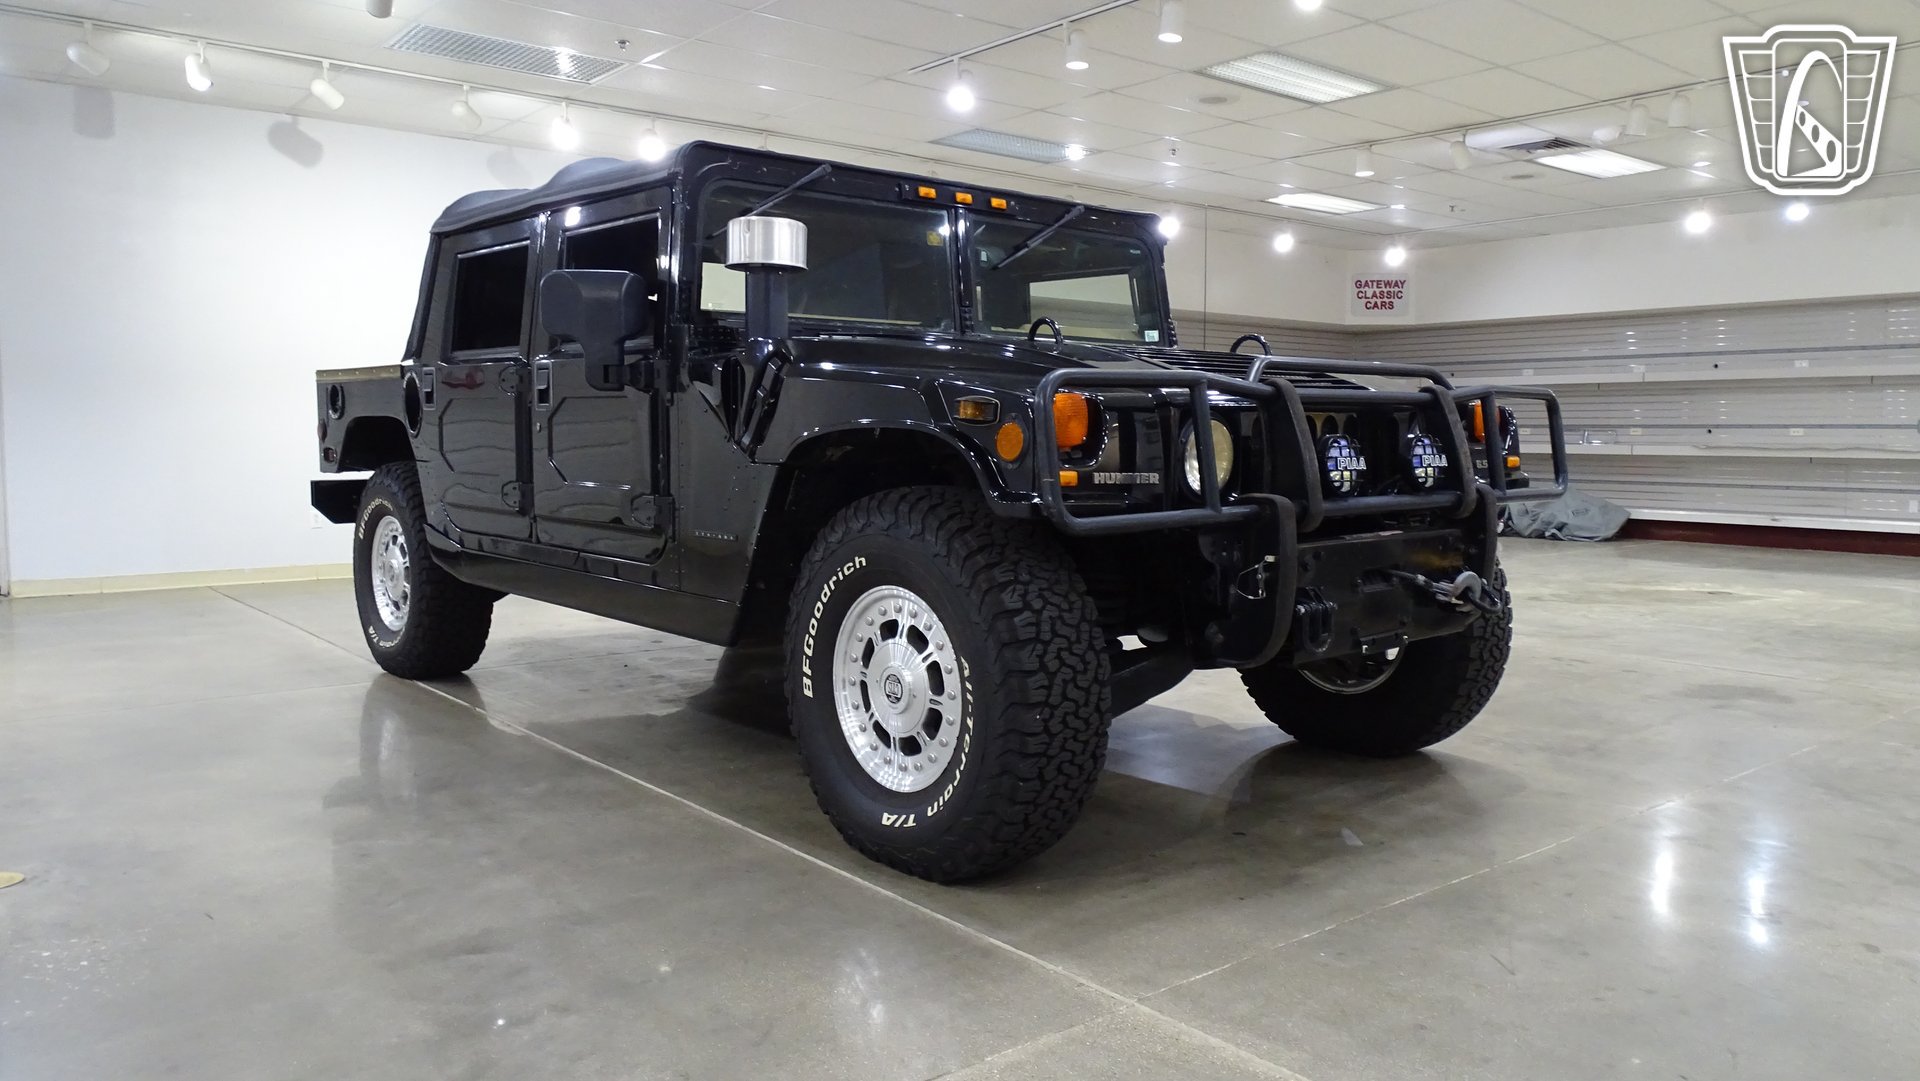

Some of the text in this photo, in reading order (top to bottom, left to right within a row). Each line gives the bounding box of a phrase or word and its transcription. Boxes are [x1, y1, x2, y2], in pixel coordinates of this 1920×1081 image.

[1354, 279, 1406, 289] GATEWAY
[1356, 290, 1404, 300] CLASSIC
[1364, 301, 1395, 310] CARS
[1337, 457, 1366, 470] PIAA
[1422, 455, 1448, 467] PIAA
[1093, 472, 1159, 484] HUMMER
[802, 556, 866, 698] BFGoodrich
[881, 812, 917, 828] T/A
